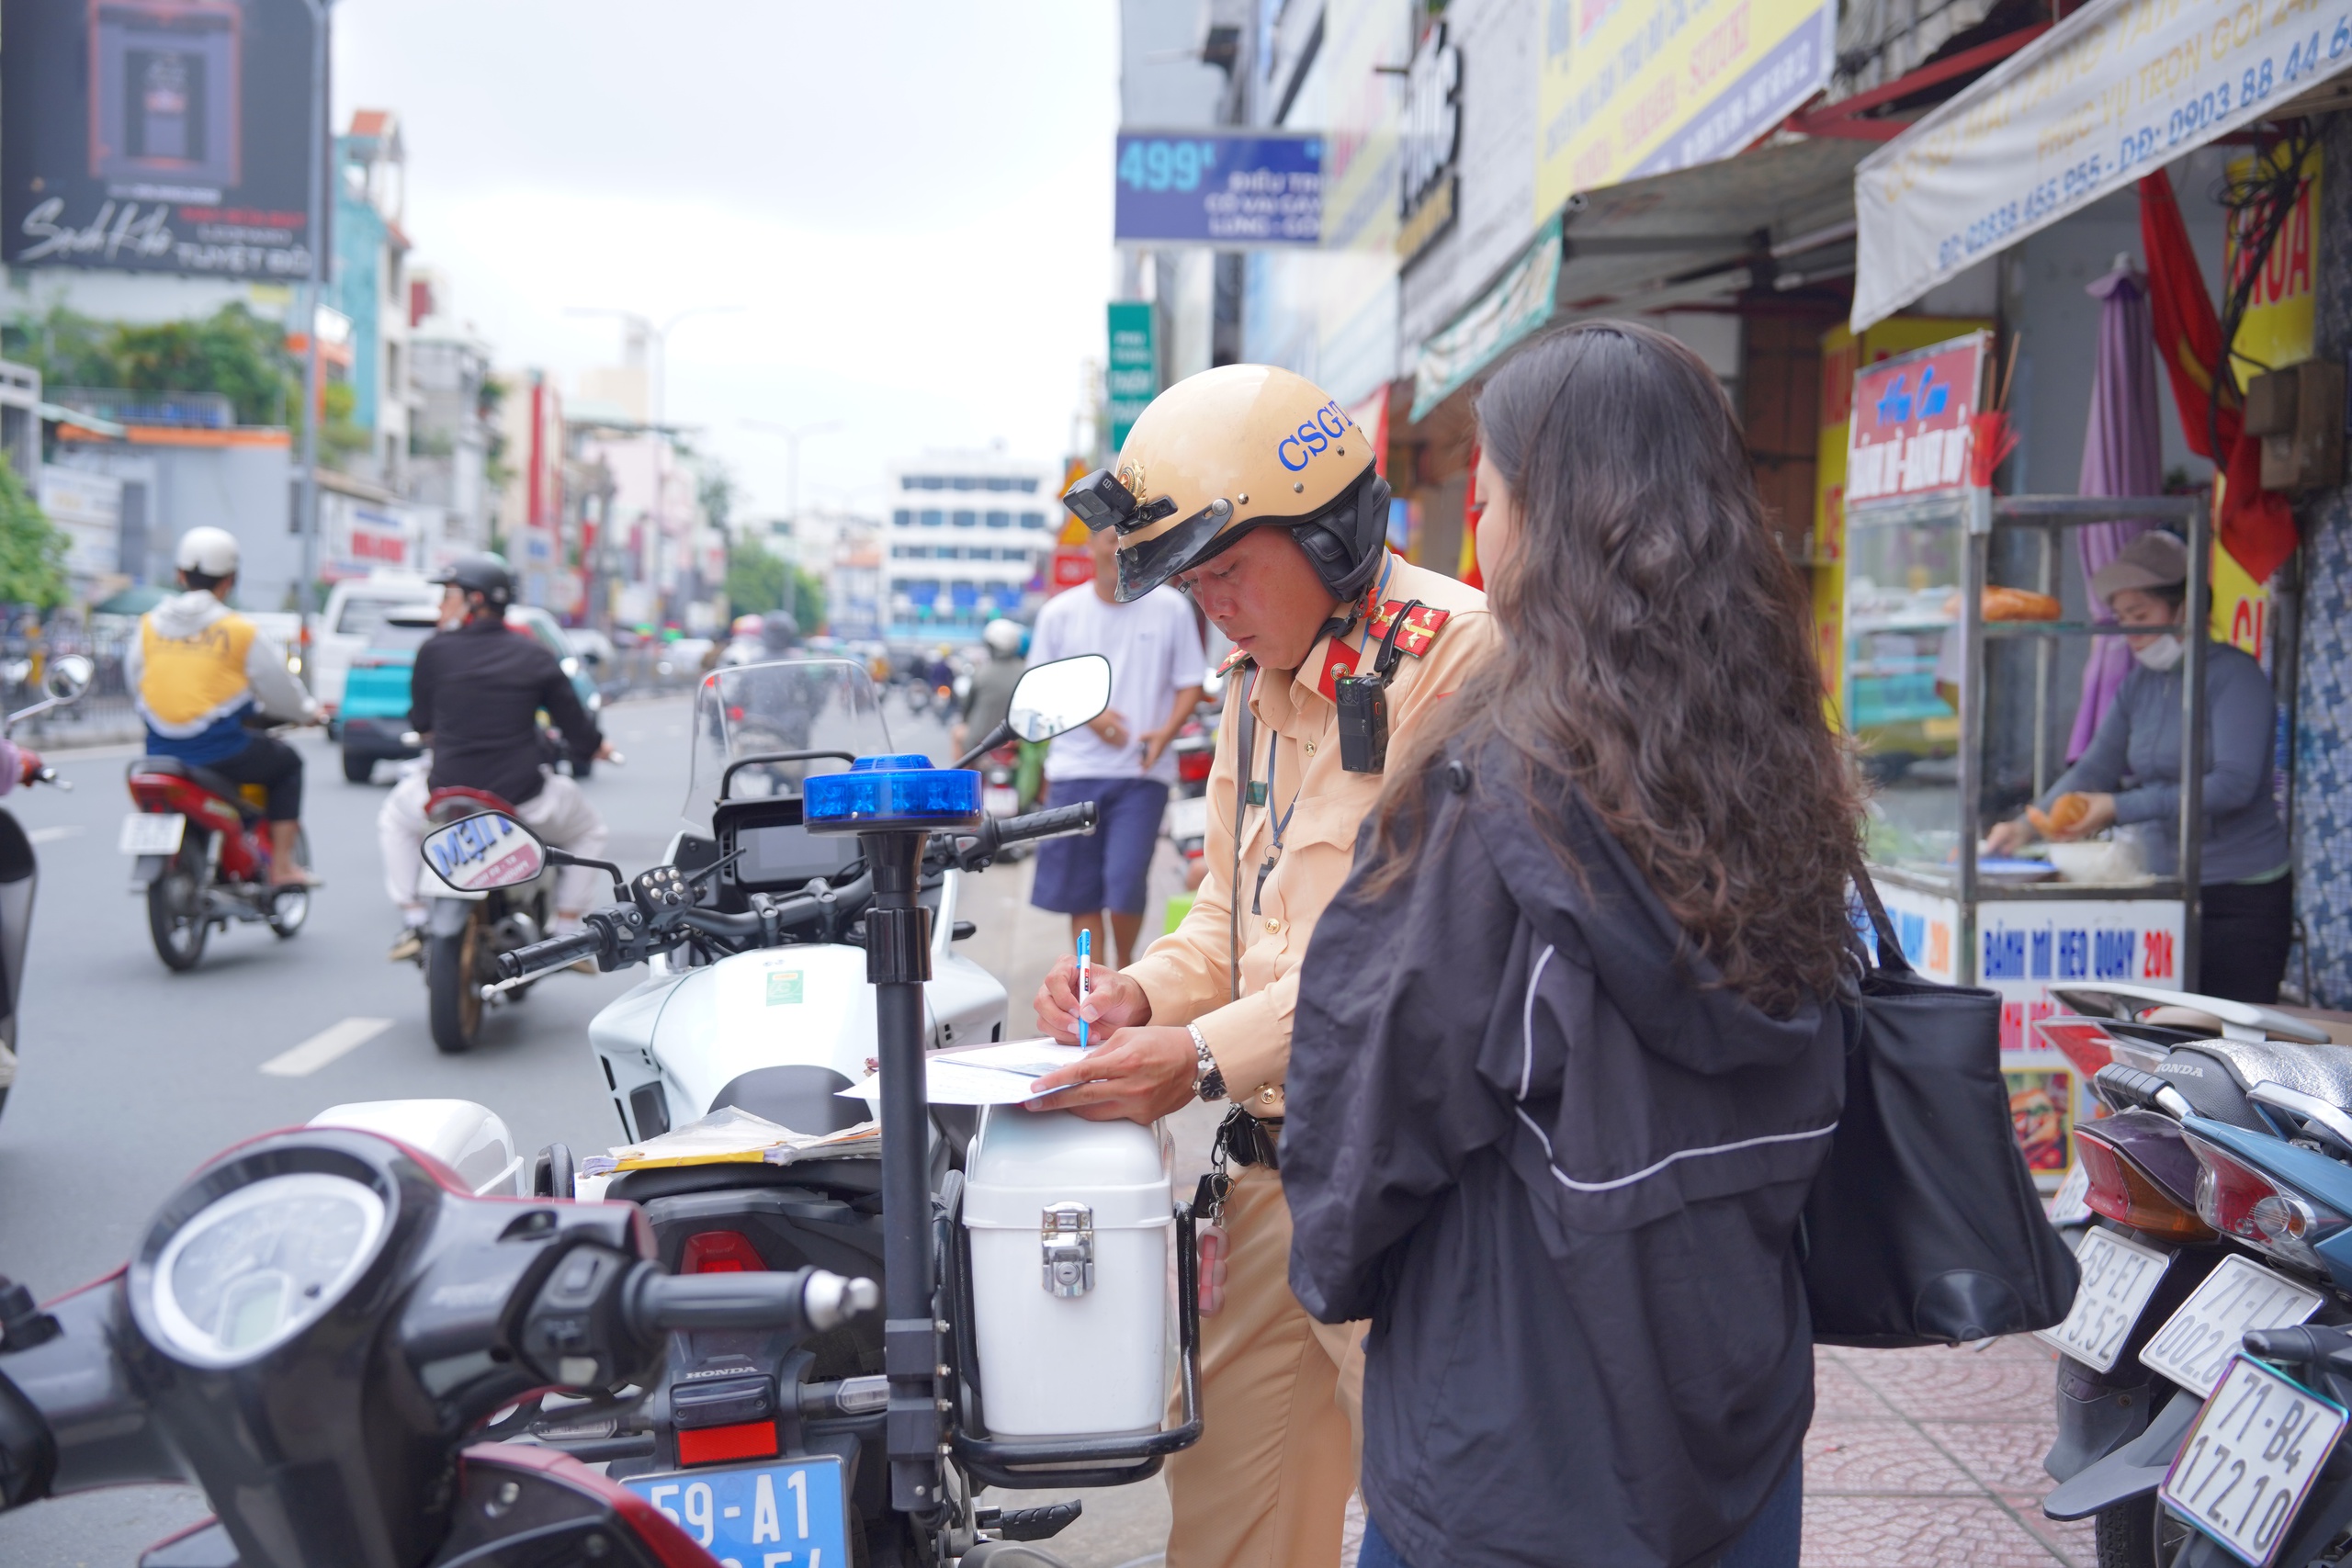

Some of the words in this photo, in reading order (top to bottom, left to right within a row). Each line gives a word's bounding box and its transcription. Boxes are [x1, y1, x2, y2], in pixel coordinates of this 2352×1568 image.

[2167, 81, 2231, 147] 0903
[2239, 56, 2274, 108] 88
[2282, 29, 2321, 81] 44
[2058, 928, 2088, 980] HEO
[2094, 929, 2136, 980] QUAY
[2058, 1296, 2129, 1360] 5.52
[685, 1365, 758, 1379] HONDA
[650, 1470, 808, 1550] 59-A1
[2176, 1435, 2291, 1553] 172.10
